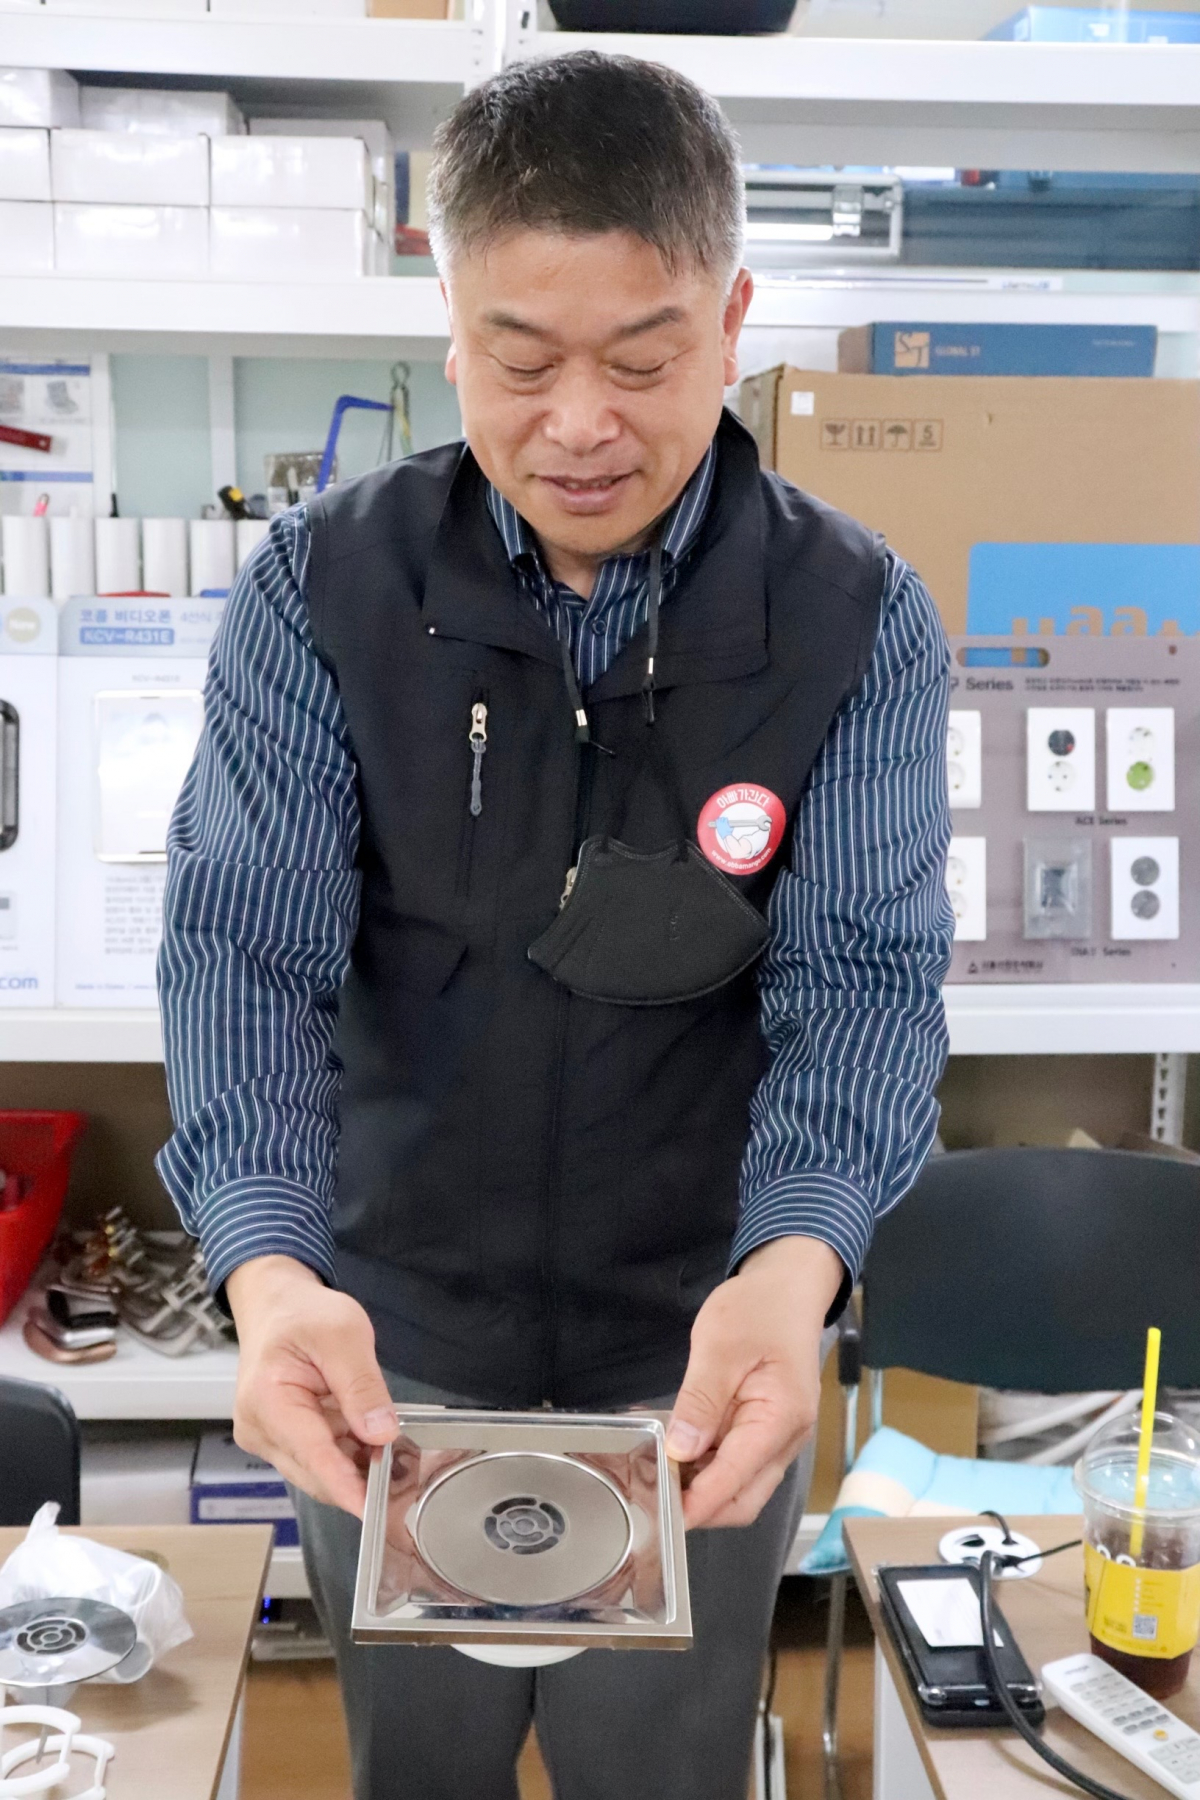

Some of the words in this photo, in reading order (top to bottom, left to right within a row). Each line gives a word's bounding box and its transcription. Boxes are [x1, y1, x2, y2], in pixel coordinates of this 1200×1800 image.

[114, 608, 171, 623] 비디오폰
[83, 628, 172, 643] KCV-R431E
[966, 677, 1014, 691] Series
